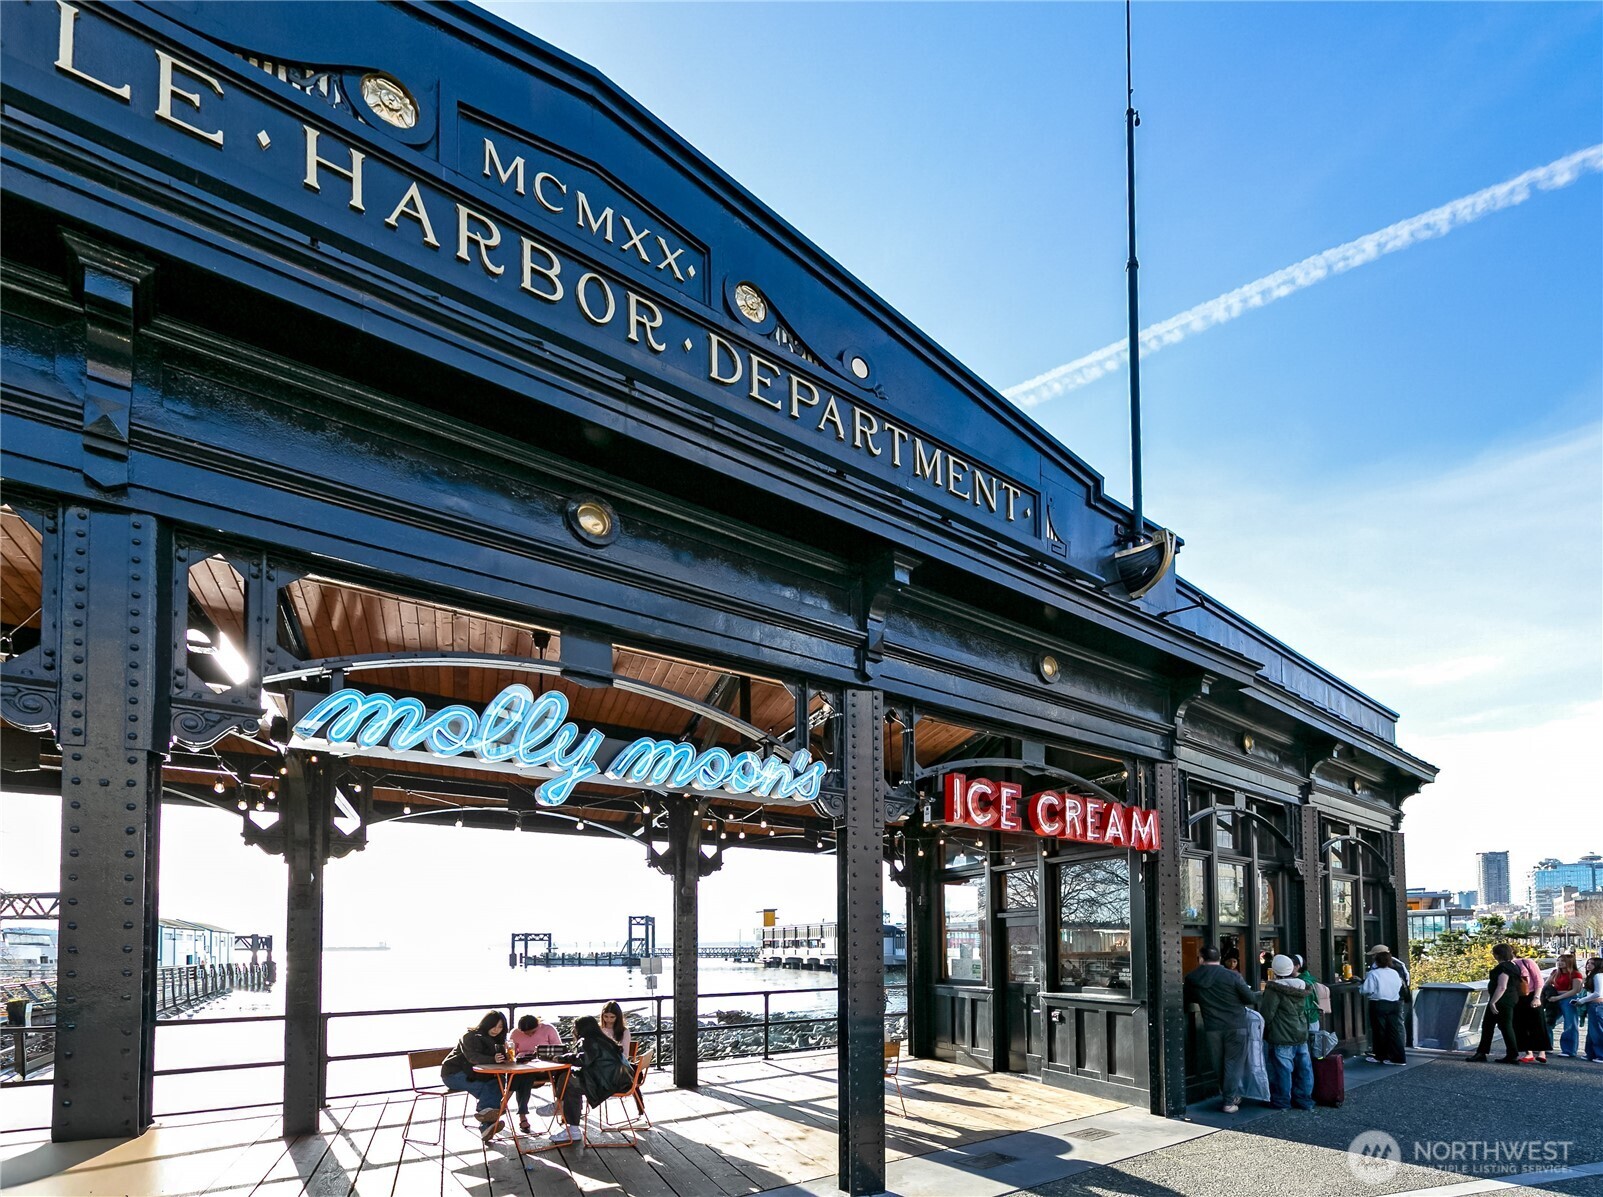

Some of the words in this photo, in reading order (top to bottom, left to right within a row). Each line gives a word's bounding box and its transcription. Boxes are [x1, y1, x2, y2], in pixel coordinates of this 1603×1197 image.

[54, 0, 225, 147] LE
[303, 124, 666, 353] HARBOR
[708, 332, 1021, 522] DEPARTMENT
[482, 138, 685, 282] MCMXX
[293, 684, 603, 806] molly
[604, 737, 827, 801] moon's
[945, 773, 1022, 831] ICE
[1028, 791, 1160, 850] CREAM
